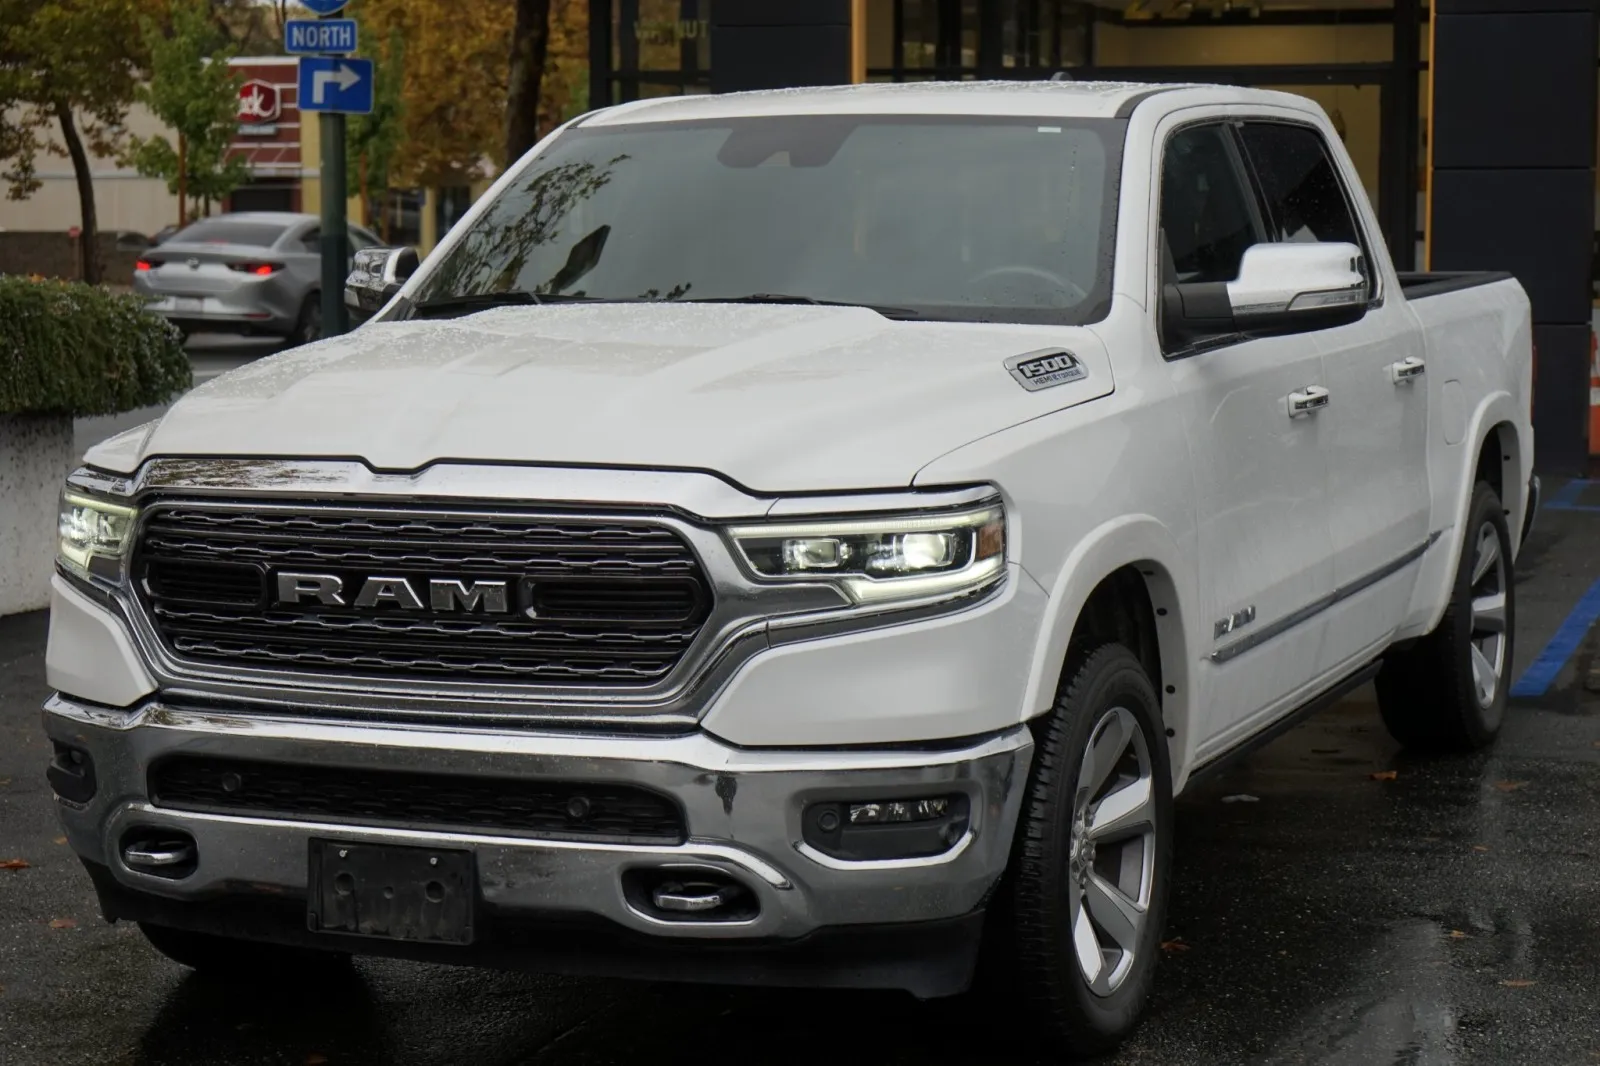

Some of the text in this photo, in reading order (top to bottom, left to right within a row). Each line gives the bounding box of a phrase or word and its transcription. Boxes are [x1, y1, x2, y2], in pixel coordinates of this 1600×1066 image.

[292, 25, 351, 47] NORTH
[1019, 355, 1073, 378] 1500
[278, 572, 508, 613] RAM
